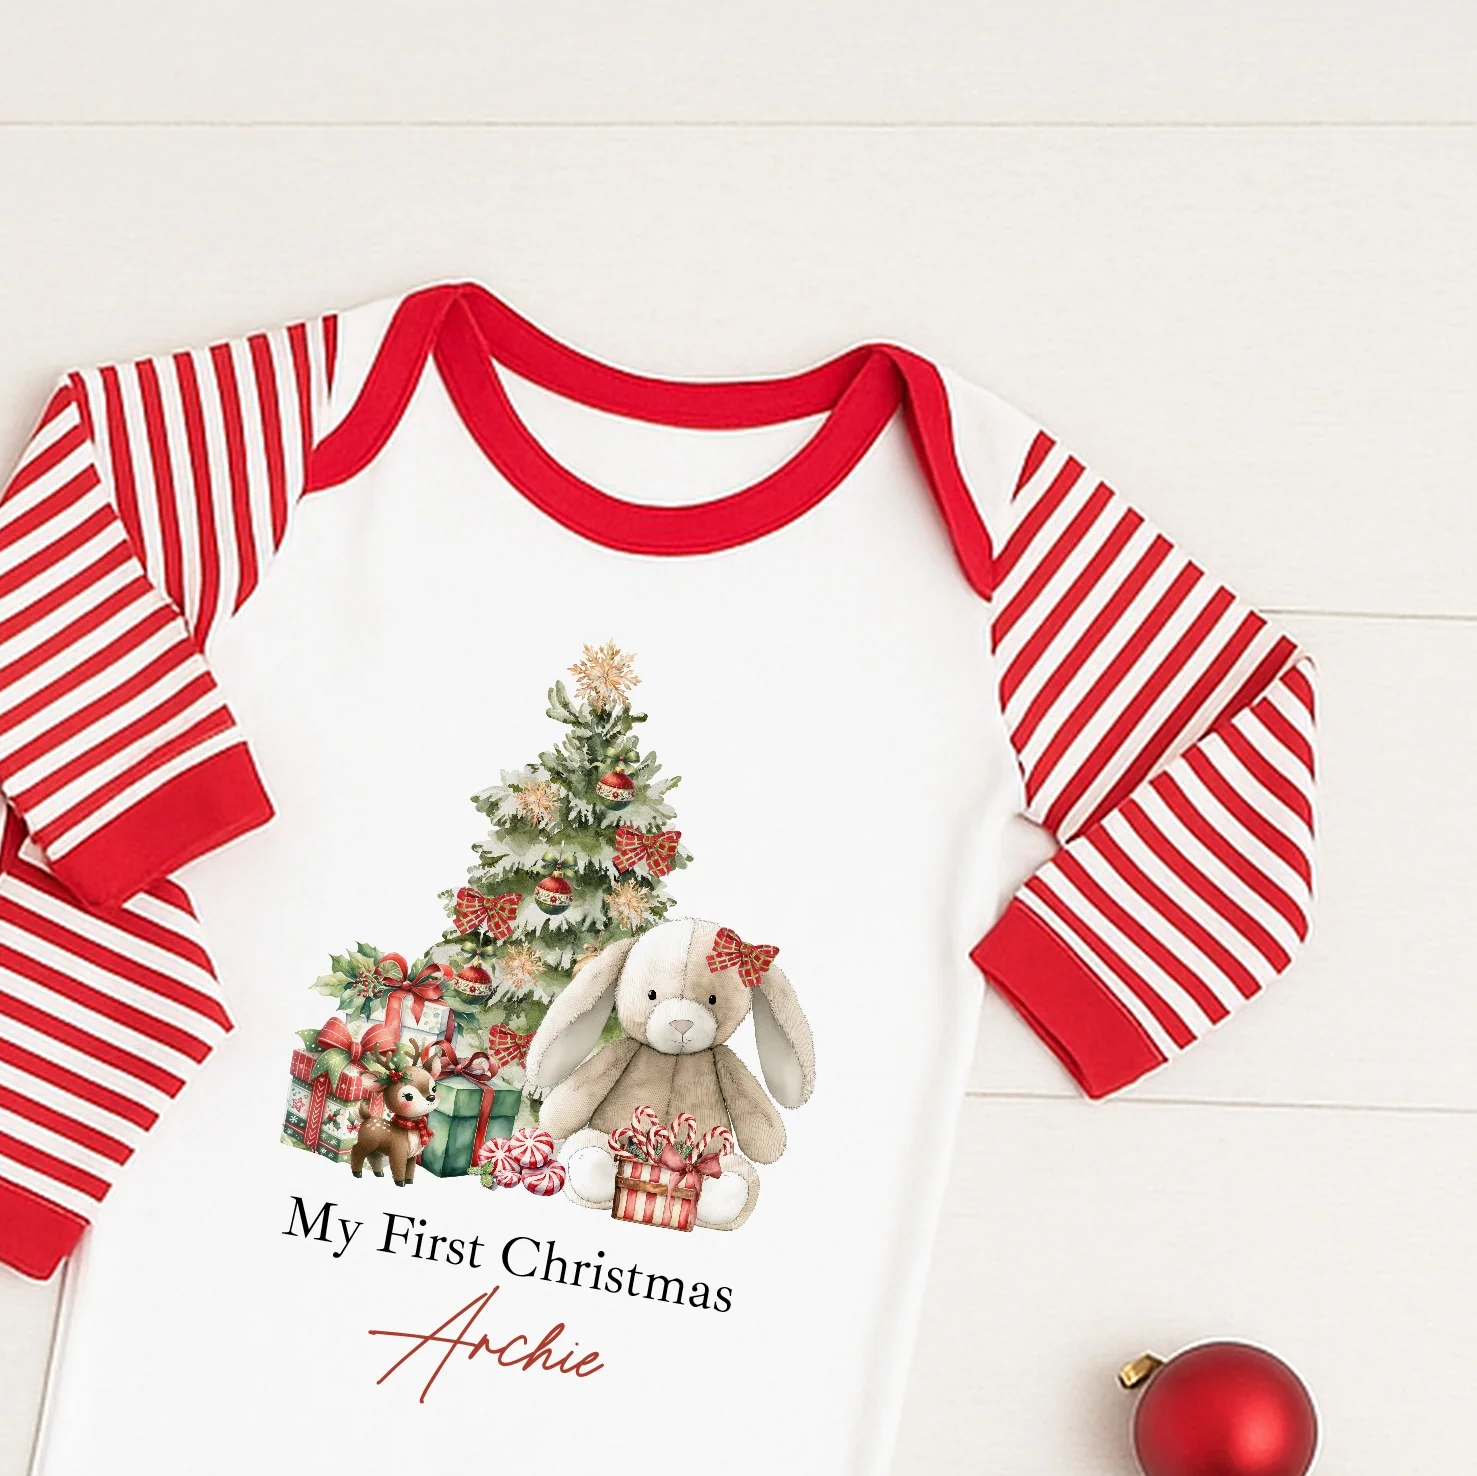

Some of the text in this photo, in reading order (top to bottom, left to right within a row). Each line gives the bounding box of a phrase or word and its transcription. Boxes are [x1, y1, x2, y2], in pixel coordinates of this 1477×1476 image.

[281, 1195, 733, 1313] My First Christmas
[367, 1284, 605, 1405] Archie
